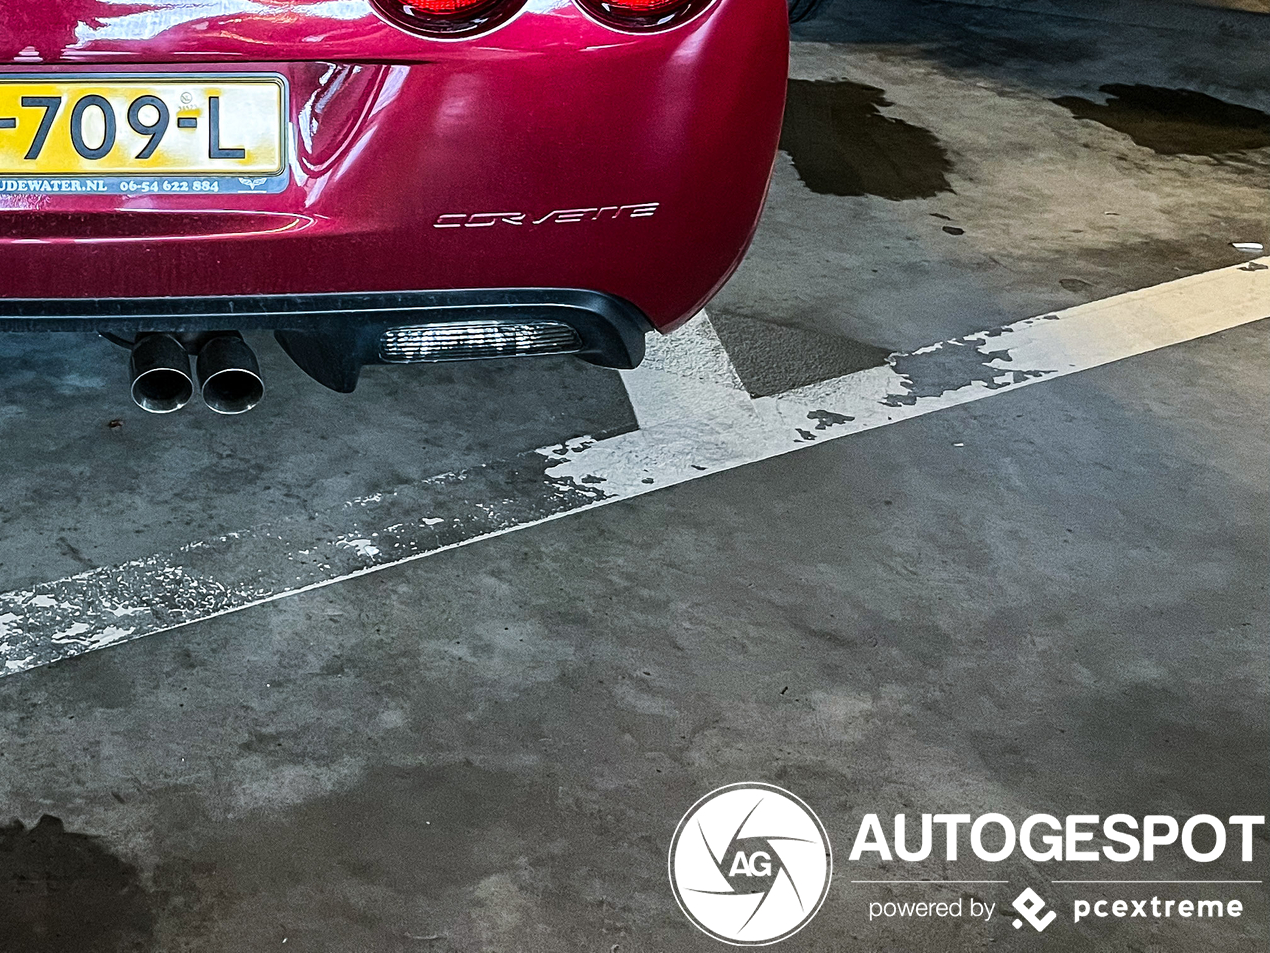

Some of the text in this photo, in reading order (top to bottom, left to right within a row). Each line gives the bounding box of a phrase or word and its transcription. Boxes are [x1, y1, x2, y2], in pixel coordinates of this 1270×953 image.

[119, 180, 159, 192] 06-54
[162, 180, 189, 192] 622
[192, 180, 220, 192] 884
